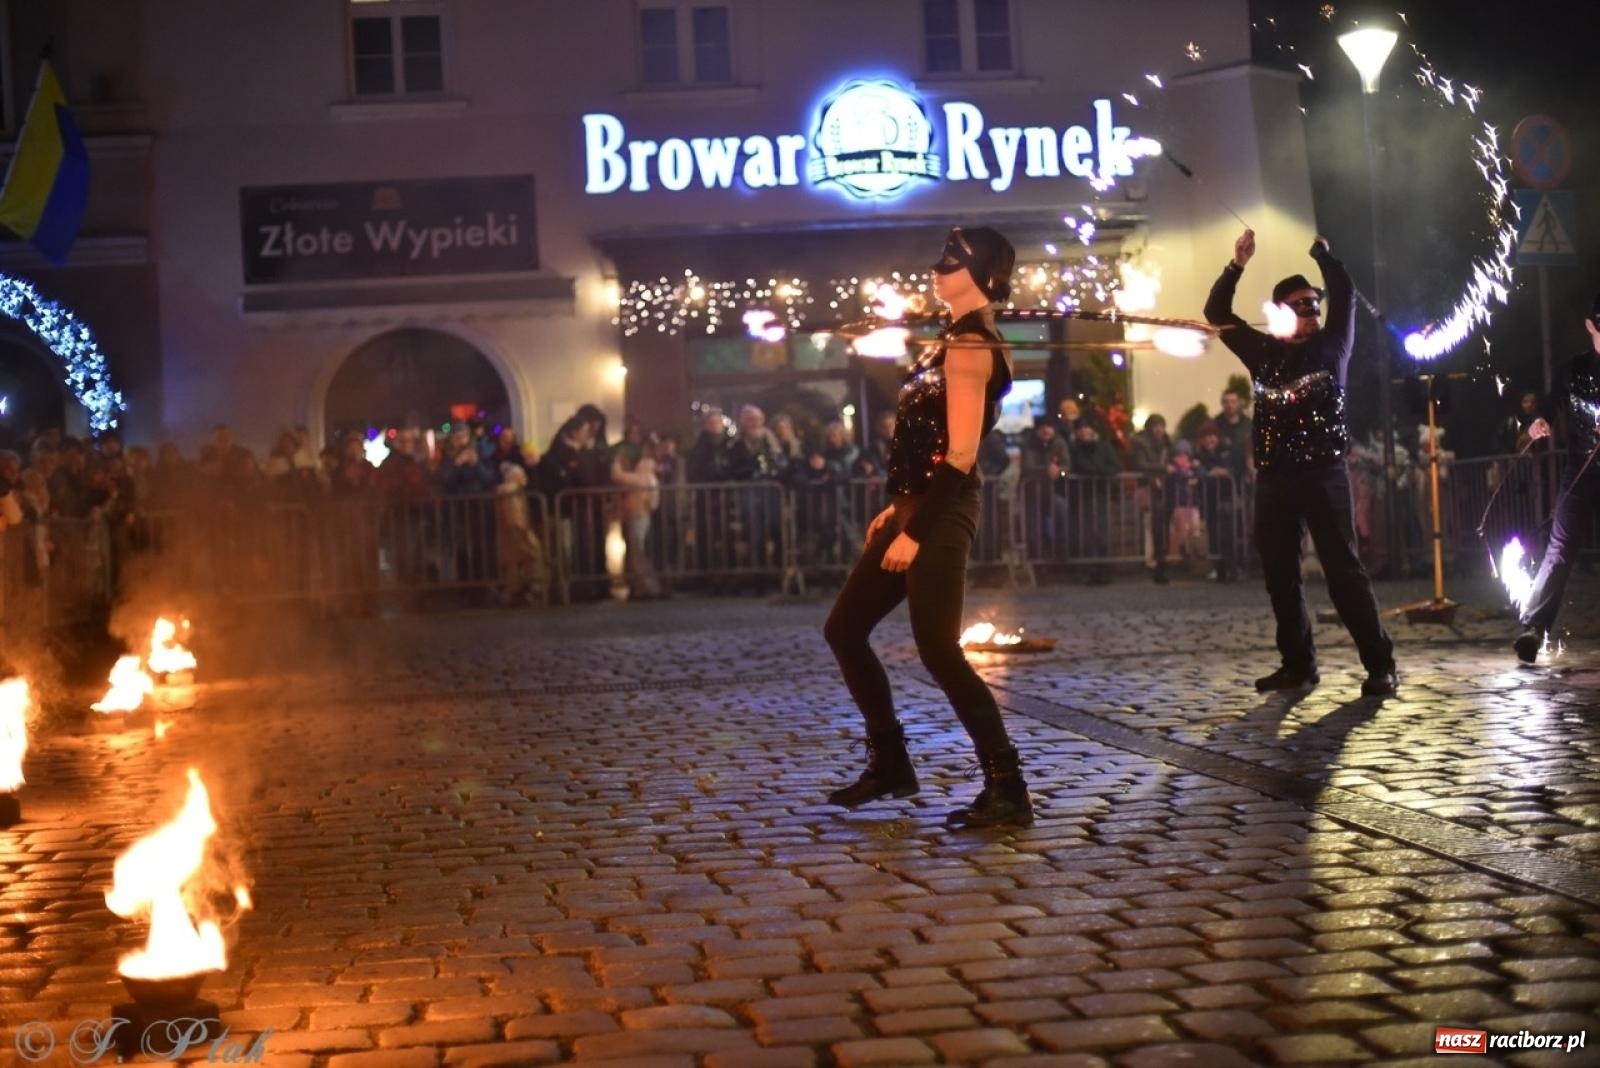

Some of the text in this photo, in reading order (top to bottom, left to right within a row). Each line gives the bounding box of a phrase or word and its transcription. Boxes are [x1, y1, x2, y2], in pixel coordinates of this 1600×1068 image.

[582, 98, 1135, 195] Browar Rynek
[258, 210, 519, 260] Złote Wypieki
